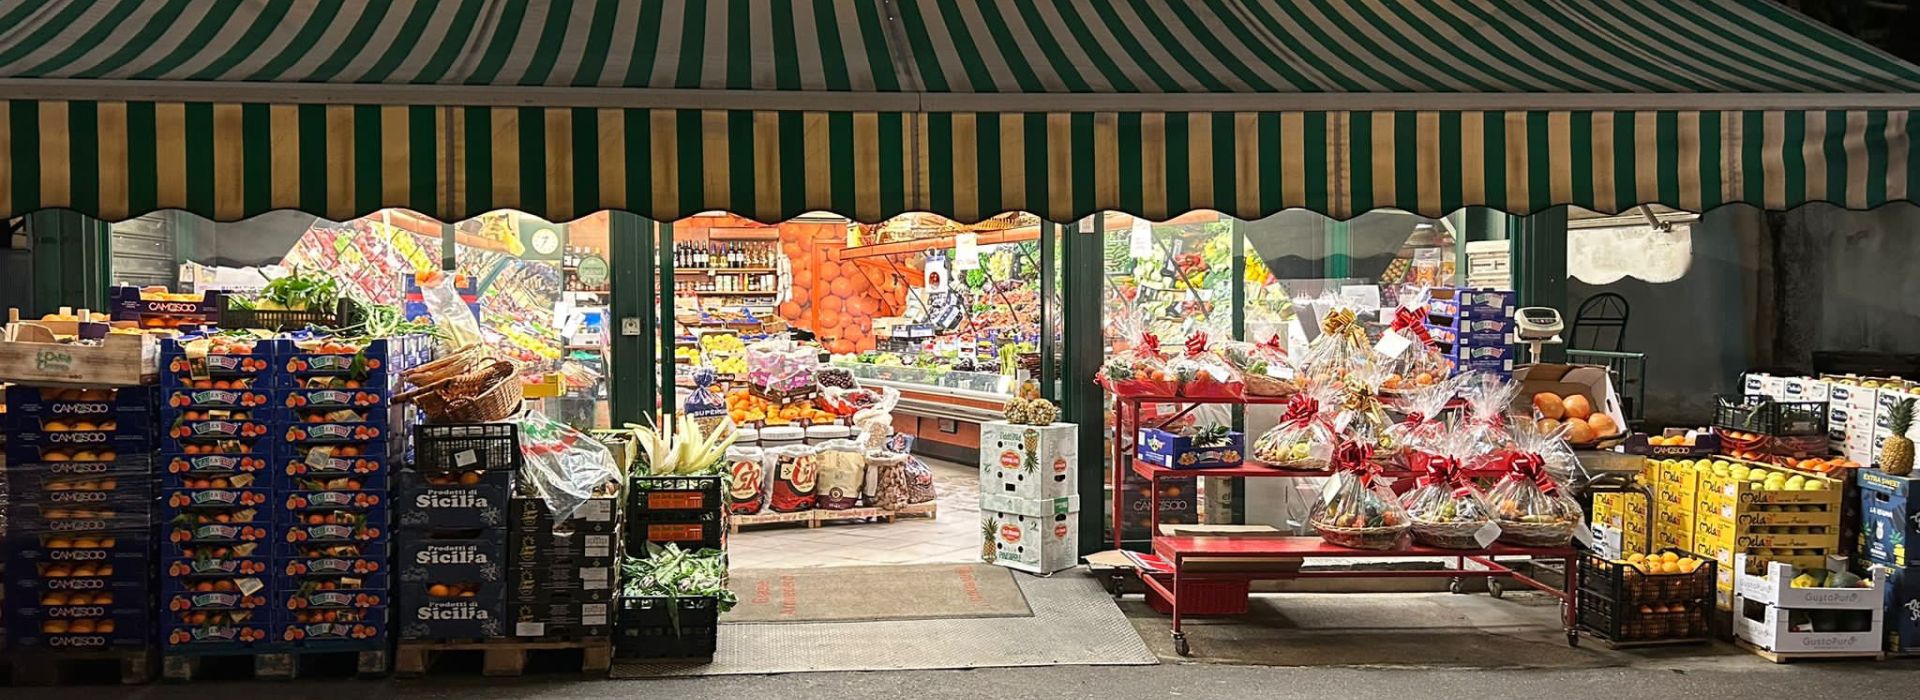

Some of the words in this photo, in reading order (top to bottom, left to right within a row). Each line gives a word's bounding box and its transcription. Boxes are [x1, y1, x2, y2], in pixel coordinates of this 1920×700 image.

[415, 494, 488, 508] Sicilia
[416, 550, 488, 565] Sicilia
[417, 606, 489, 620] Sicilia
